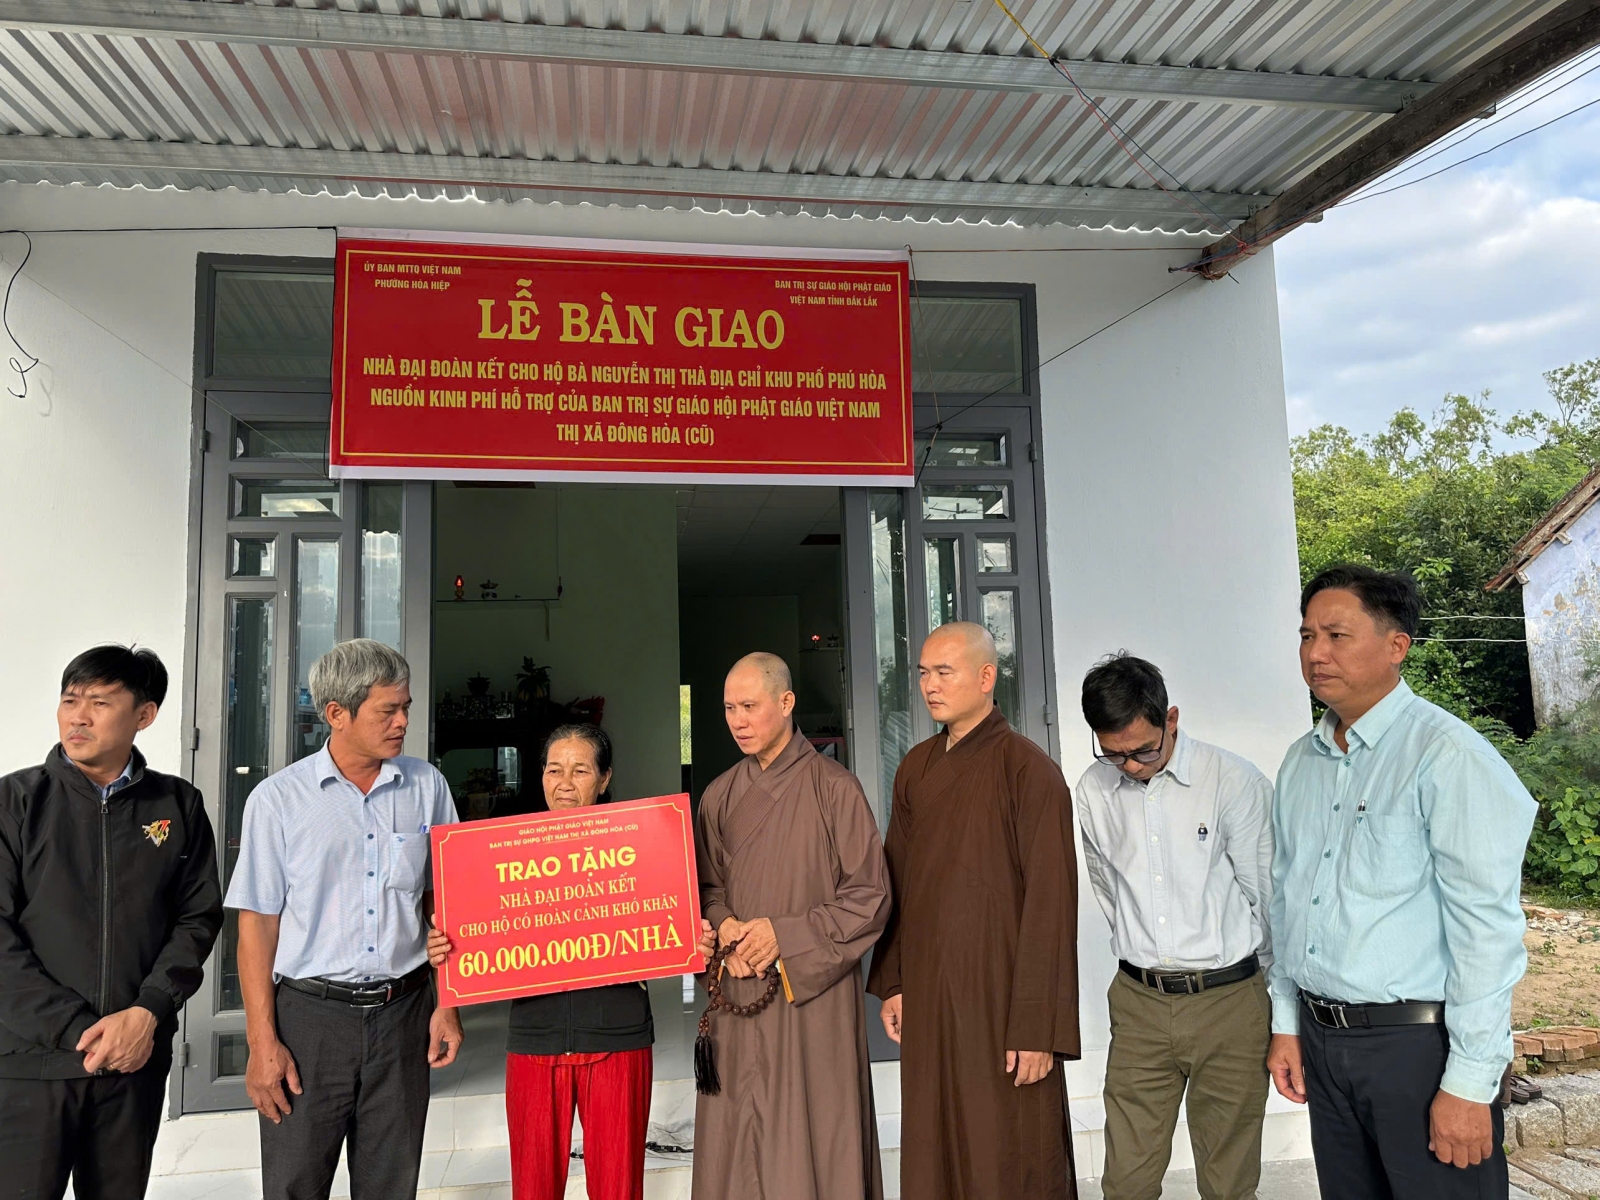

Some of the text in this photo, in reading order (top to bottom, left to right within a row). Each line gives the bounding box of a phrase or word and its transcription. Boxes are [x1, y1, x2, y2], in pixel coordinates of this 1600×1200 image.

[364, 261, 461, 275] ỦY BAN MTTQ VIỆT NAM
[374, 278, 409, 288] PHƯỜNG
[431, 280, 450, 291] HIỆP
[775, 280, 891, 293] BAN TRỊ SỰ GIÁO HỘI PHẬT GIÁO
[478, 279, 784, 349] LỄ BÀN GIAO
[364, 355, 886, 390] NHÀ ĐẠI ĐOÀN KẾT CHO HỘ BÀ NGUYỄN THỊ THÀ ĐỊA CHỈ KHU PHỐ PHÚ HÒA
[371, 384, 880, 421] NGUỒN KINH PHÍ HỖ TRỢ CỦA BAN TRỊ SỰ GIÁO HỘI PHẬT GIÁO VIỆT NAM
[557, 422, 714, 446] THỊ XÃ ĐÔNG HÒA (CŨ)
[536, 826, 547, 834] HỘI
[582, 820, 594, 828] VIỆT
[495, 846, 636, 883] TRAO TẶNG
[499, 872, 636, 910] NHÀ ĐẠI ĐOÀN KẾT
[459, 895, 678, 938] CHO HỘ CÓ HOÀN CẢNH KHÓ KHĂN
[458, 915, 683, 978] 60.000.000Đ/NHÀ
